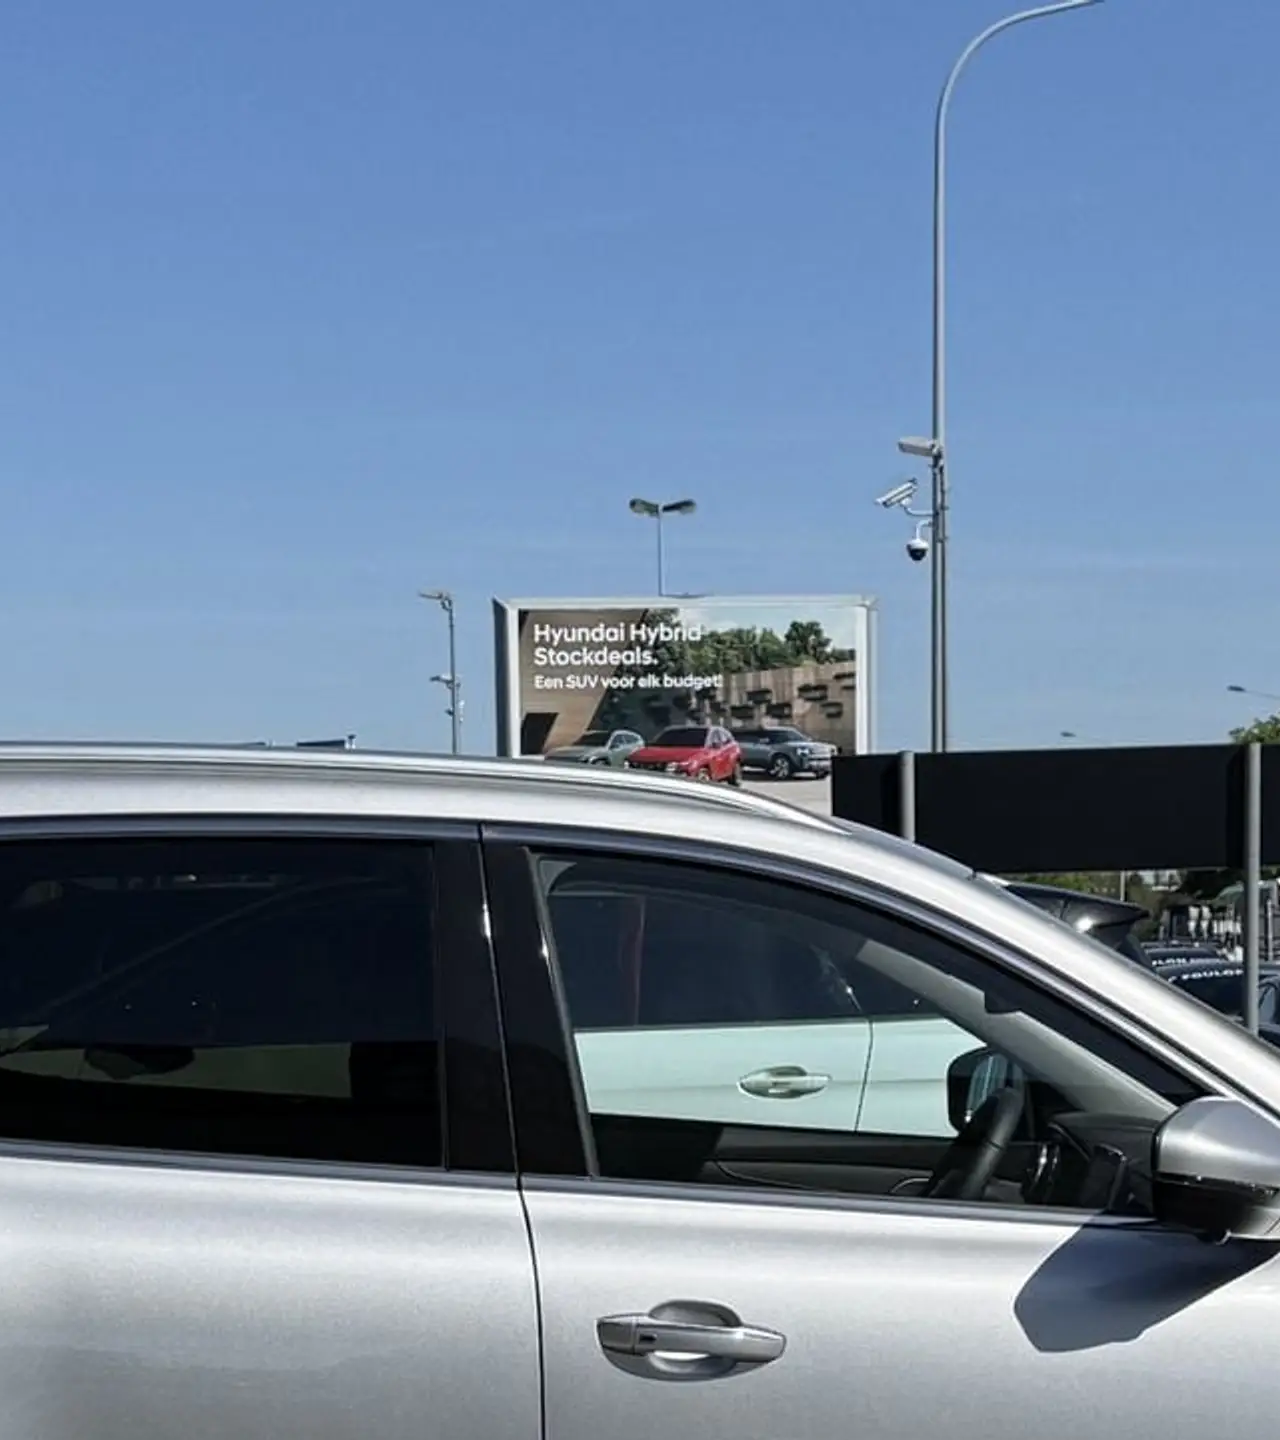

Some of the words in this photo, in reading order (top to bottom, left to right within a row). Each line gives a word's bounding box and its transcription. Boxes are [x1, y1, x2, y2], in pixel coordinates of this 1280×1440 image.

[533, 622, 625, 647] Hyundai
[629, 622, 702, 646] Hybrid
[533, 646, 659, 666] Stockdeals.
[534, 675, 564, 689] Een
[566, 674, 599, 689] SUV
[600, 675, 635, 689] voor
[637, 673, 661, 689] elk
[663, 672, 724, 691] budget!
